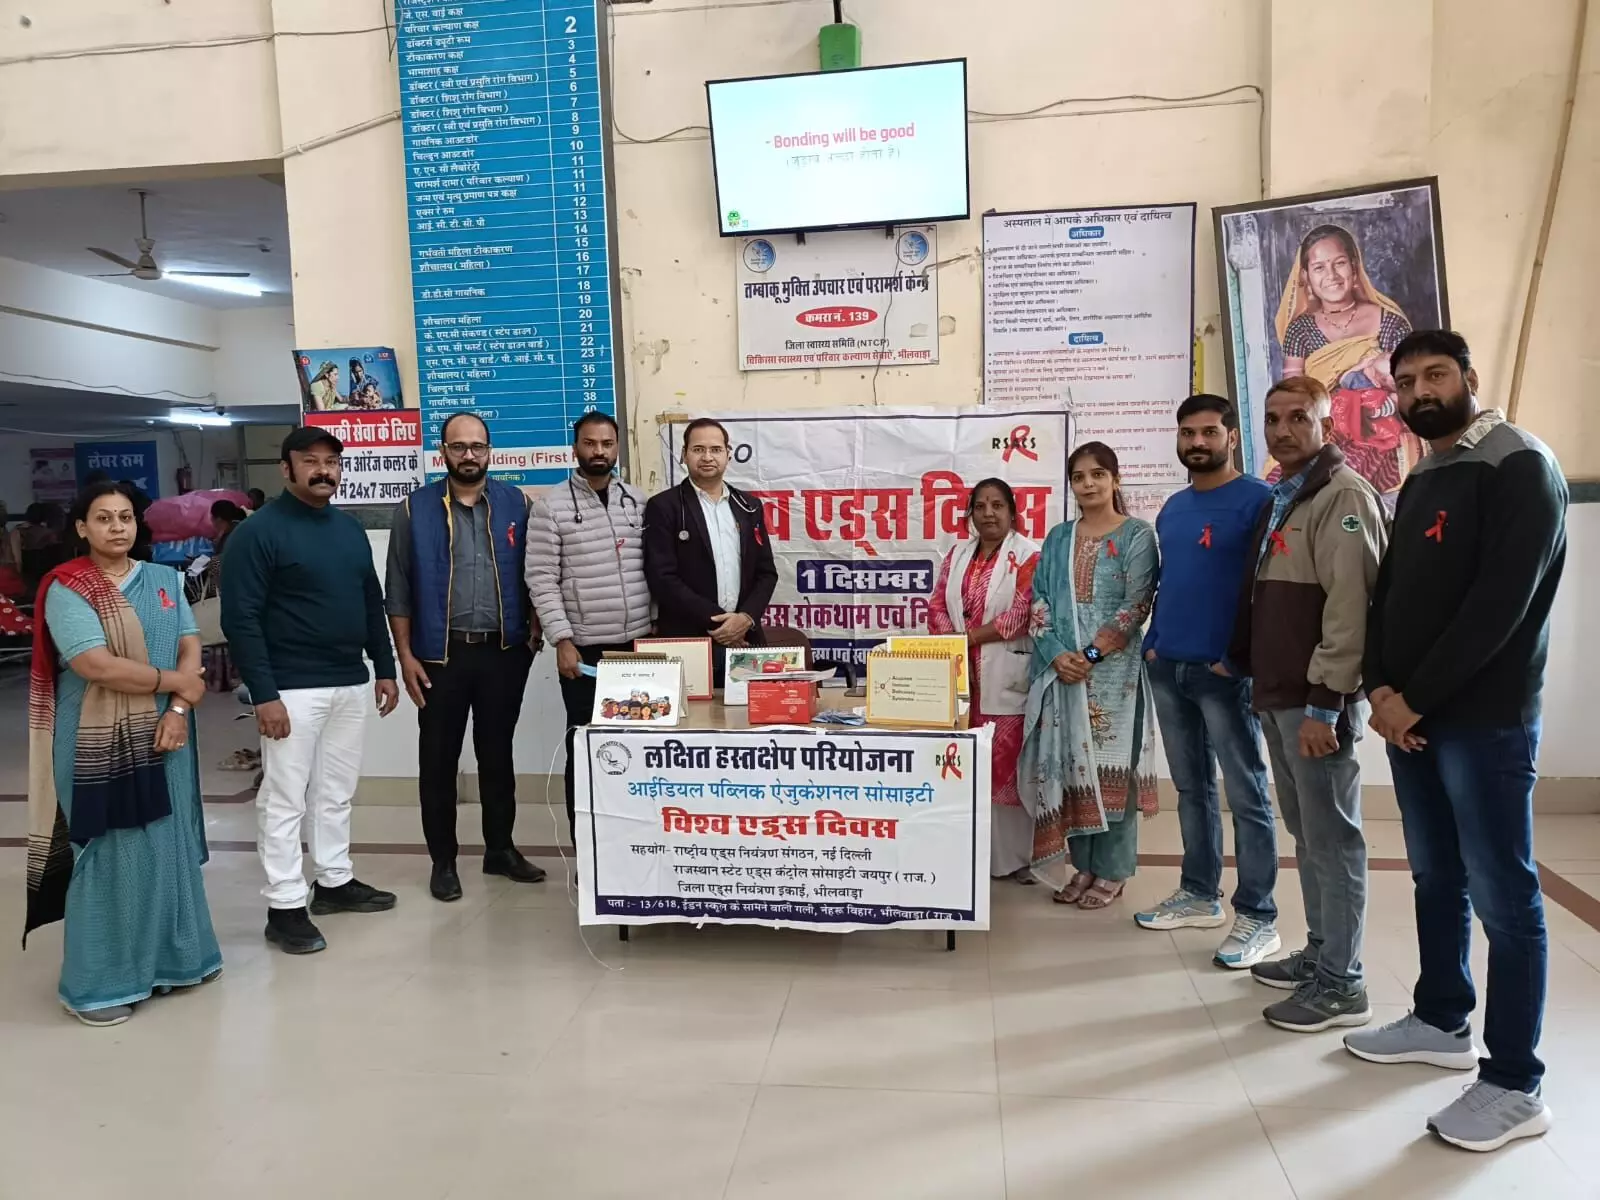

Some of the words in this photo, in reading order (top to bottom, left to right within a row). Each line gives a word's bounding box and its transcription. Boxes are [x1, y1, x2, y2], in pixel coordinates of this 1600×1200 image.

[404, 23, 430, 34] परिवार
[565, 16, 577, 33] 2
[568, 40, 575, 50] 3
[406, 52, 446, 62] टीकाकरण
[568, 54, 577, 64] 4
[569, 67, 577, 78] 5
[569, 81, 577, 92] 6
[570, 97, 578, 107] 7
[571, 112, 579, 122] 8
[572, 125, 579, 135] 9
[774, 131, 829, 148] Bonding
[833, 127, 856, 143] will
[860, 126, 877, 141] be
[880, 121, 914, 142] good
[570, 140, 584, 151] 10
[571, 155, 584, 166] 11
[572, 169, 585, 179] 11
[573, 182, 585, 192] 11
[573, 196, 587, 207] 12
[574, 210, 587, 220] 13
[1003, 217, 1042, 229] अस्पताल
[1054, 213, 1082, 225] आपके
[1083, 212, 1121, 224] अधिकार
[1124, 211, 1138, 223] एवं
[1139, 209, 1173, 222] दायित्व
[574, 224, 588, 234] 14
[1071, 229, 1102, 239] अधिकार
[575, 237, 589, 247] 15
[447, 246, 472, 257] महिला
[473, 245, 513, 255] टीकाकरण
[576, 251, 590, 262] 16
[576, 265, 590, 275] 17
[577, 281, 591, 291] 18
[744, 281, 780, 303] तम्बाकू
[812, 278, 845, 296] उपचार
[847, 272, 865, 295] एवं
[866, 271, 903, 293] परामर्श
[578, 295, 591, 305] 19
[579, 309, 592, 319] 20
[805, 312, 832, 323] कमरा
[849, 311, 869, 322] 139
[423, 317, 456, 326] शौचालय
[458, 315, 482, 324] महिला
[580, 323, 593, 333] 21
[580, 336, 594, 346] 22
[785, 339, 805, 351] जिला
[832, 337, 856, 348] समिति
[581, 348, 595, 358] 23
[816, 352, 840, 362] परिवार
[842, 351, 871, 361] कल्याण
[582, 364, 595, 374] 36
[427, 370, 459, 380] शौचालय
[582, 378, 596, 388] 37
[583, 392, 597, 401] 38
[352, 418, 376, 442] सेवा
[377, 417, 389, 441] के
[390, 417, 418, 441] लिए
[88, 451, 119, 469] लेबर
[383, 456, 407, 472] कलर
[408, 450, 418, 471] के
[349, 482, 376, 499] 24x7
[804, 487, 914, 556] एड्स
[920, 470, 1053, 540] दिस
[801, 569, 816, 589] 1
[824, 564, 930, 590] दिसम्बर
[793, 596, 872, 629] रोकथाम
[875, 596, 908, 629] एवं
[644, 739, 712, 769] लक्षित
[715, 738, 797, 770] हस्तक्षेप
[800, 740, 914, 772] परियोजना
[628, 776, 704, 800] आईडियल
[708, 778, 766, 800] पब्लिक
[864, 780, 935, 806] सोसाइटी
[661, 807, 732, 835] विश्व
[736, 814, 810, 841] एड्स
[814, 809, 899, 840] दिवस
[673, 844, 708, 860] राष्ट्रीय
[710, 847, 736, 861] एड्स
[738, 845, 778, 859] नियंत्रण
[821, 846, 837, 861] नई
[840, 847, 872, 861] दिल्ली
[673, 864, 719, 876] राजस्थान
[720, 863, 743, 876] स्टेट
[745, 867, 772, 879] एड्स
[775, 864, 808, 880] कंट्रोल
[811, 865, 856, 882] सोसाइटी
[859, 869, 892, 884] जयपुर
[677, 880, 705, 893] जिला
[708, 884, 733, 897] एड्स
[736, 882, 775, 895] नियंत्रण
[813, 884, 863, 900] भीलवाड़ा
[607, 899, 624, 908] पता
[704, 901, 727, 913] स्कूल
[729, 901, 740, 911] के
[743, 901, 768, 913] सामने
[770, 902, 792, 913] वाली
[820, 904, 845, 916] नेहरू
